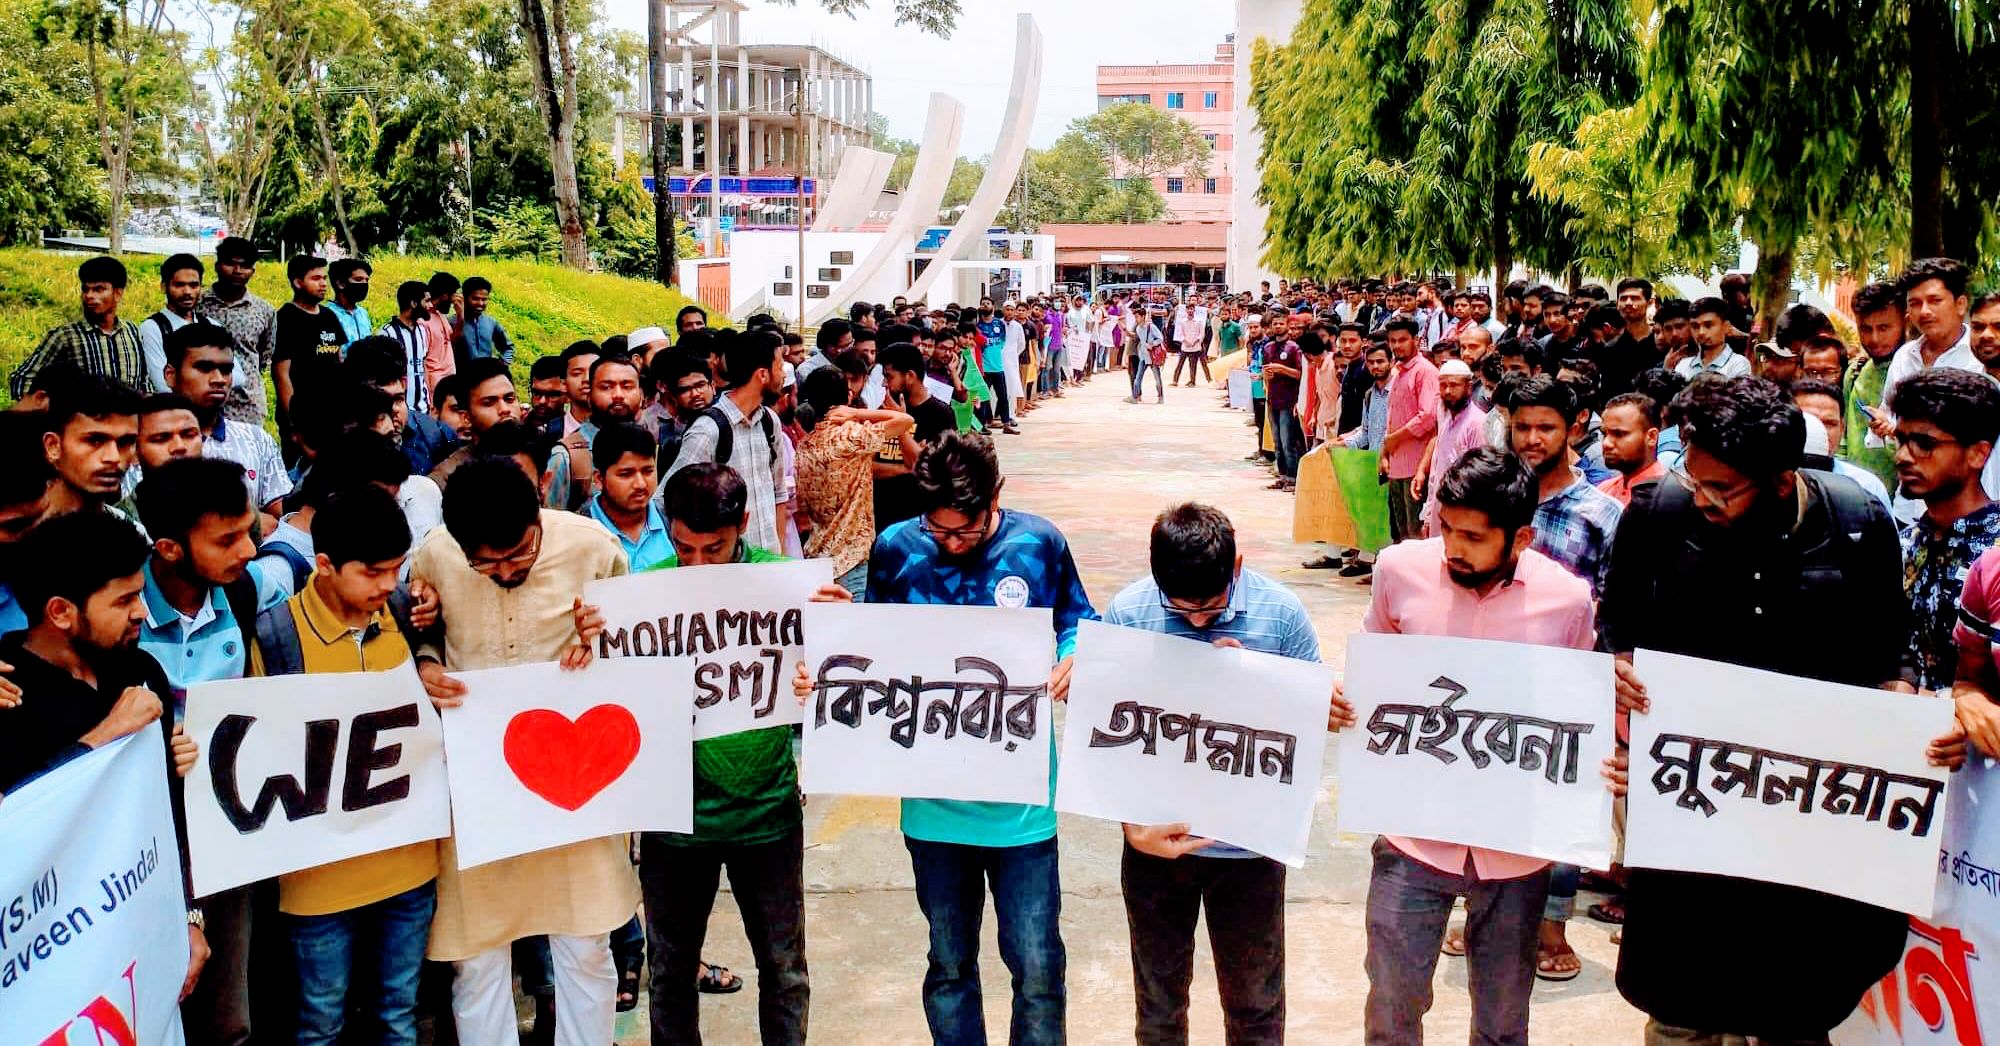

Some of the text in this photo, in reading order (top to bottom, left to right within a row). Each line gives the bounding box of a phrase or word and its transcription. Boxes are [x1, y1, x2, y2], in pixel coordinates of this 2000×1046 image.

[600, 608, 804, 659] MOHAMMA
[693, 648, 783, 724] SM]
[812, 655, 1048, 752] বিশ্বনবীর
[1366, 675, 1594, 785] সইবেনা
[209, 703, 420, 834] WE
[1089, 700, 1297, 785] অপমান
[1650, 732, 1944, 838] মুসলমান
[2, 836, 160, 988] aveen Jindal
[1952, 850, 2000, 897] প্রতিবা
